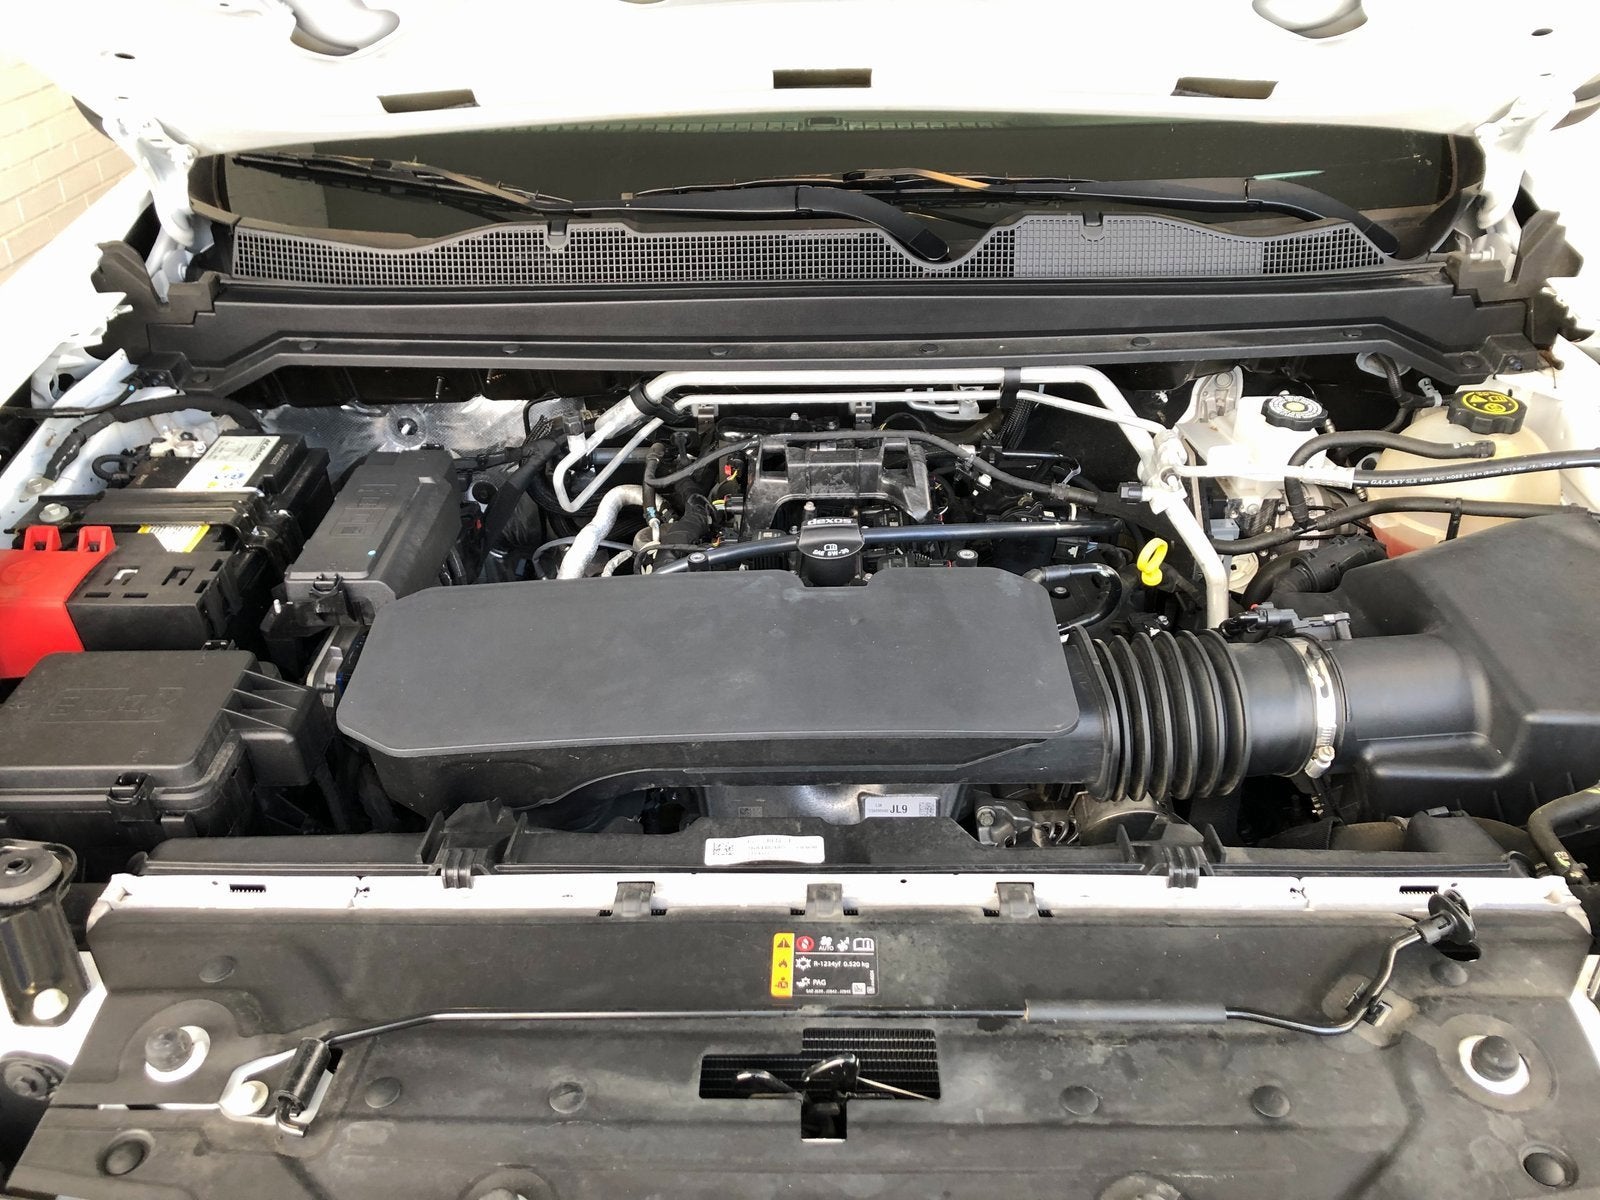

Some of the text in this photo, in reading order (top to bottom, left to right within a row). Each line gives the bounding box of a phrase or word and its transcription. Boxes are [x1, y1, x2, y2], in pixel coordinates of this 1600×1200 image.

[807, 518, 852, 526] dexos
[889, 804, 908, 814] JL9
[813, 960, 841, 969] R-1234yf
[861, 961, 870, 969] kg
